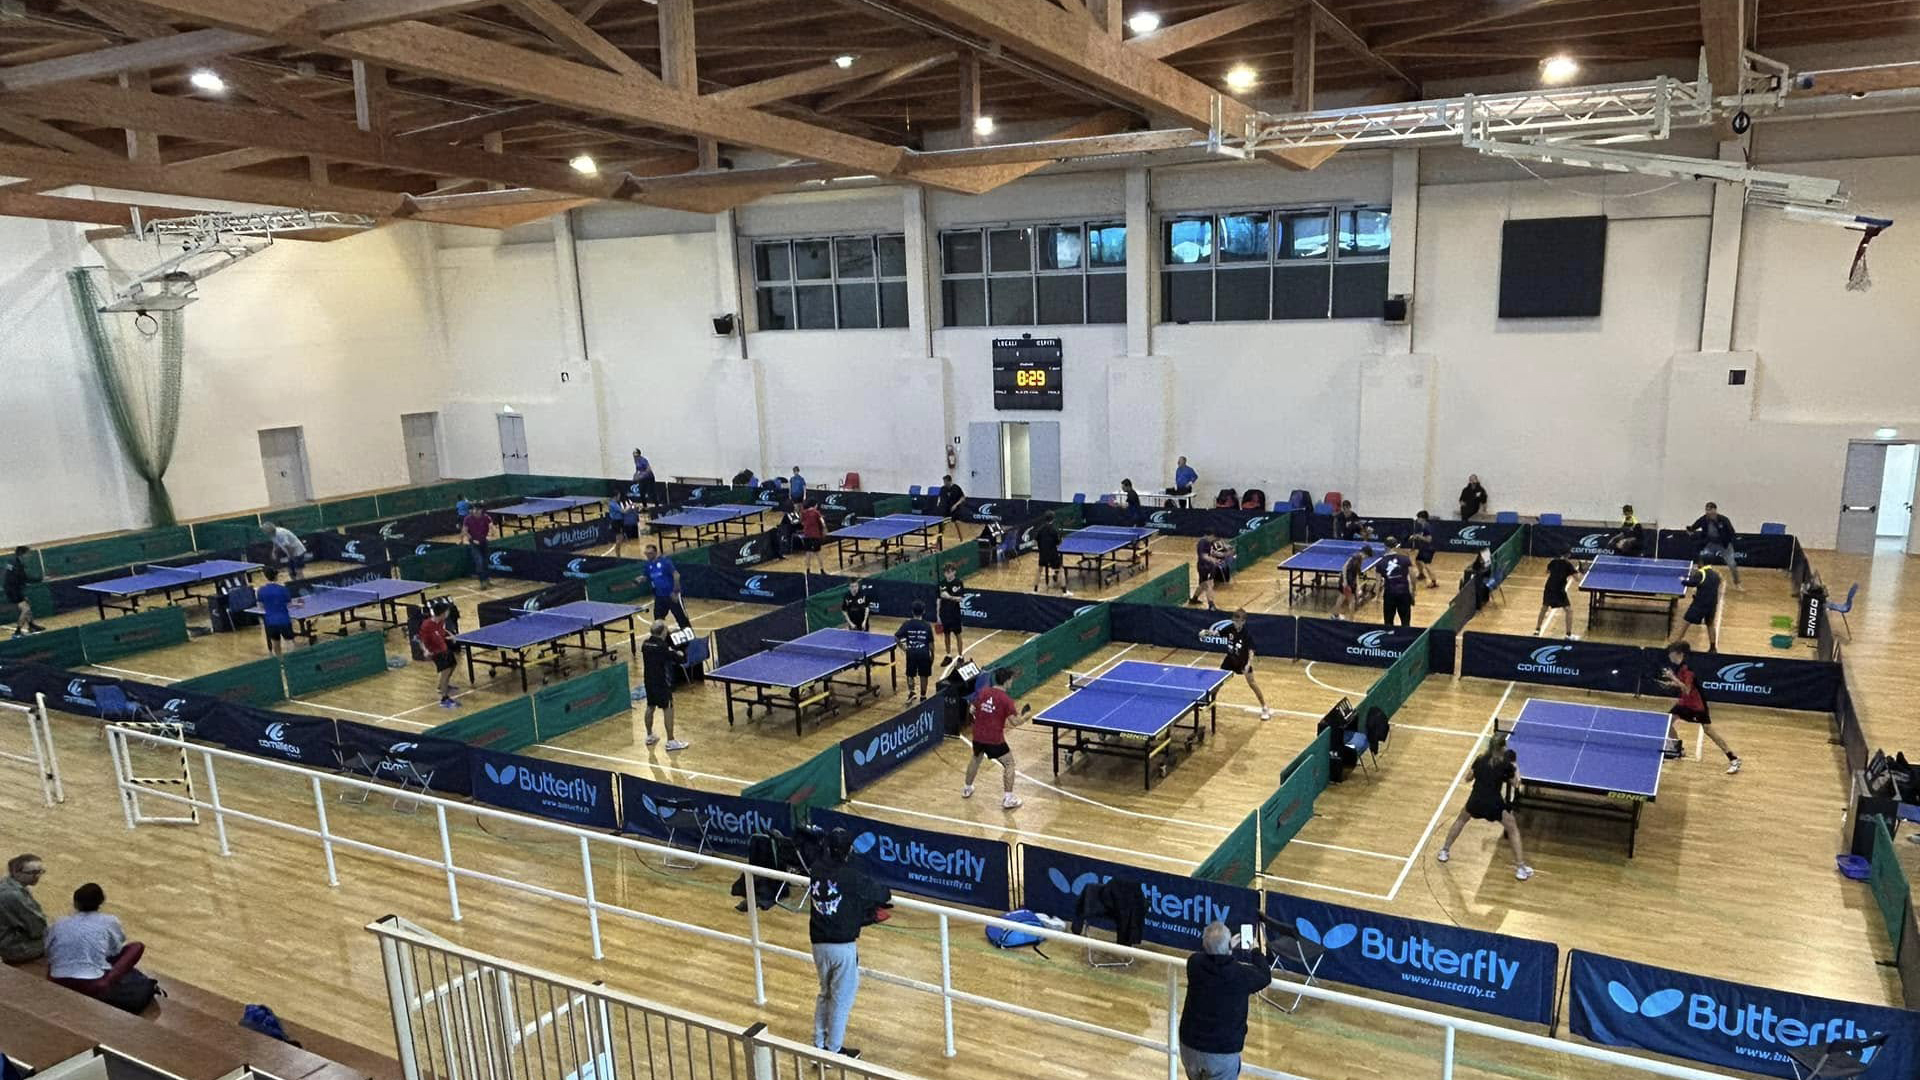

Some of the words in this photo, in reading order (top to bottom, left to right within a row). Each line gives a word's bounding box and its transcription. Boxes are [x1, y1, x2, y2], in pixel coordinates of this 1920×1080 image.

[1017, 370, 1046, 386] 8:29
[1807, 598, 1819, 637] DONIC
[1346, 646, 1402, 658] cornilleau
[1517, 663, 1580, 676] cornilleau
[1702, 680, 1772, 695] cornilleau
[880, 710, 935, 756] Butterfly
[519, 766, 597, 806] Butterfly
[704, 804, 772, 835] tterfly
[878, 835, 986, 882] Butterfly
[1361, 927, 1520, 990] Butterfly
